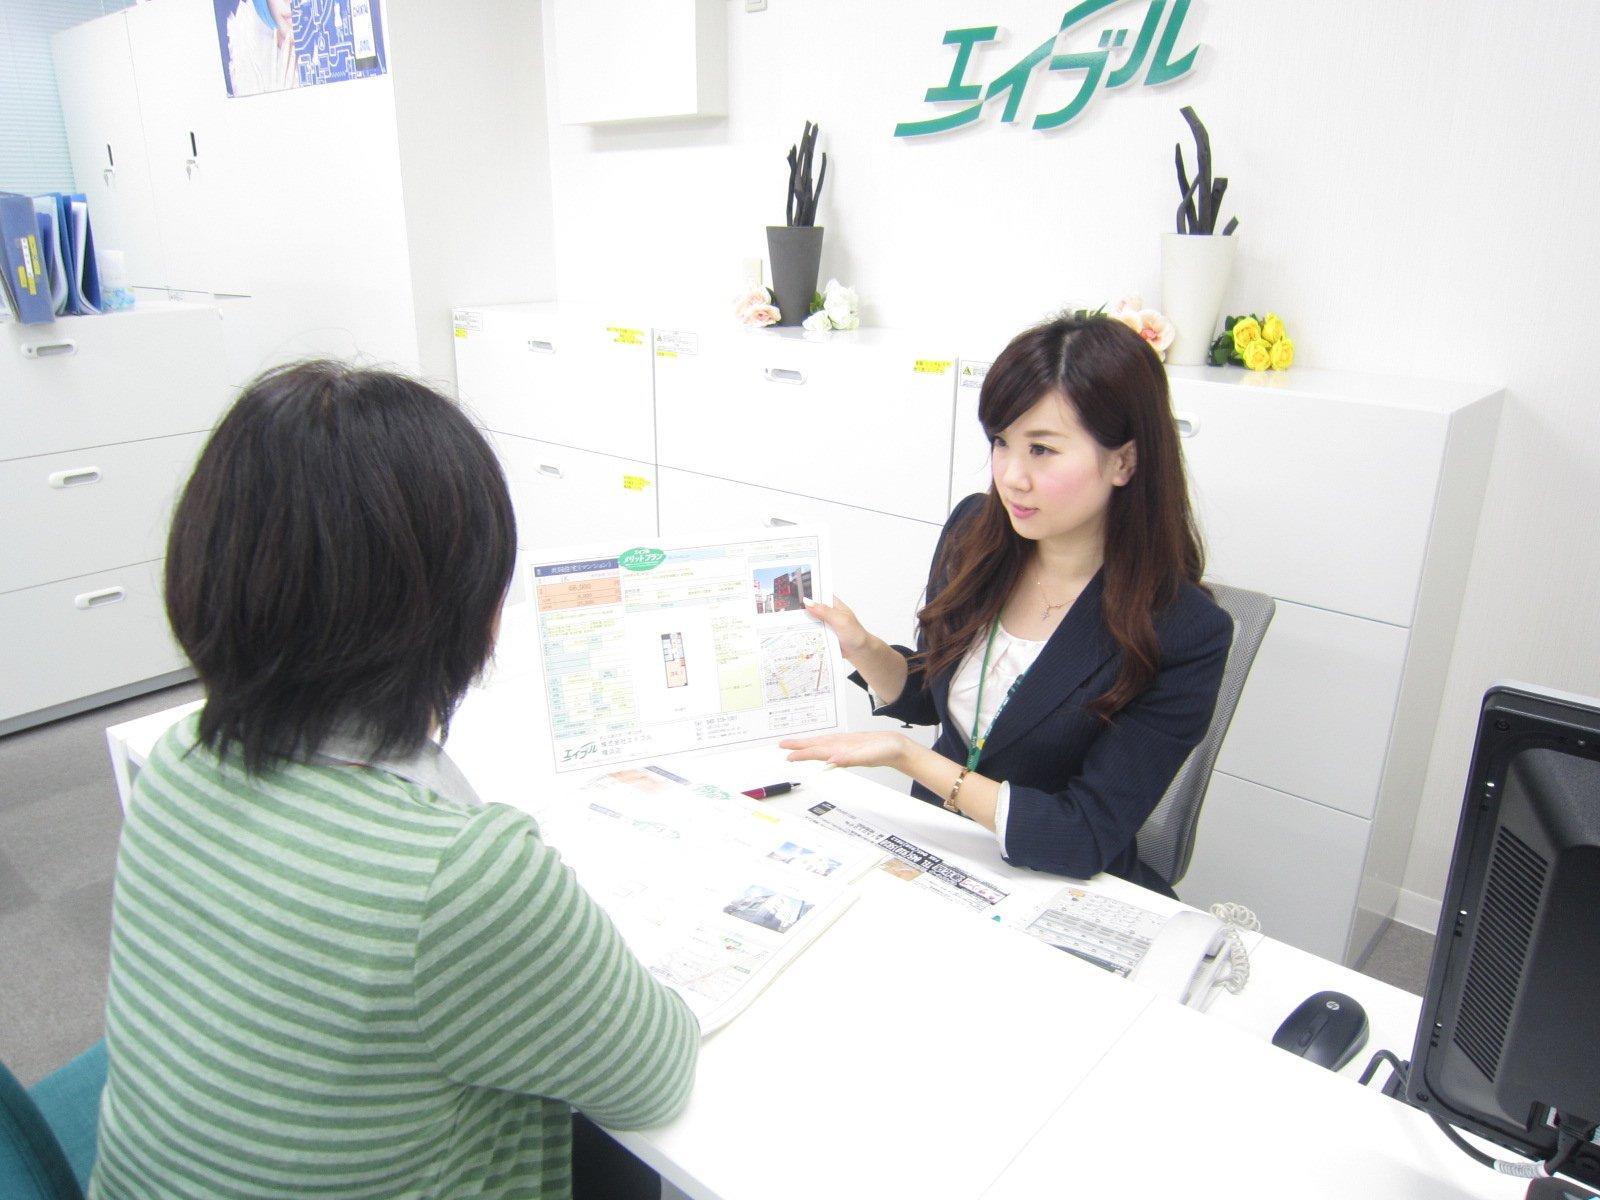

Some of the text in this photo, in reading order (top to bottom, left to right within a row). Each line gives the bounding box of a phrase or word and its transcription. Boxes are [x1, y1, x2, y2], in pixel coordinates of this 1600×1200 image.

[894, 0, 1200, 137] エイブル
[562, 741, 598, 762] エイブル
